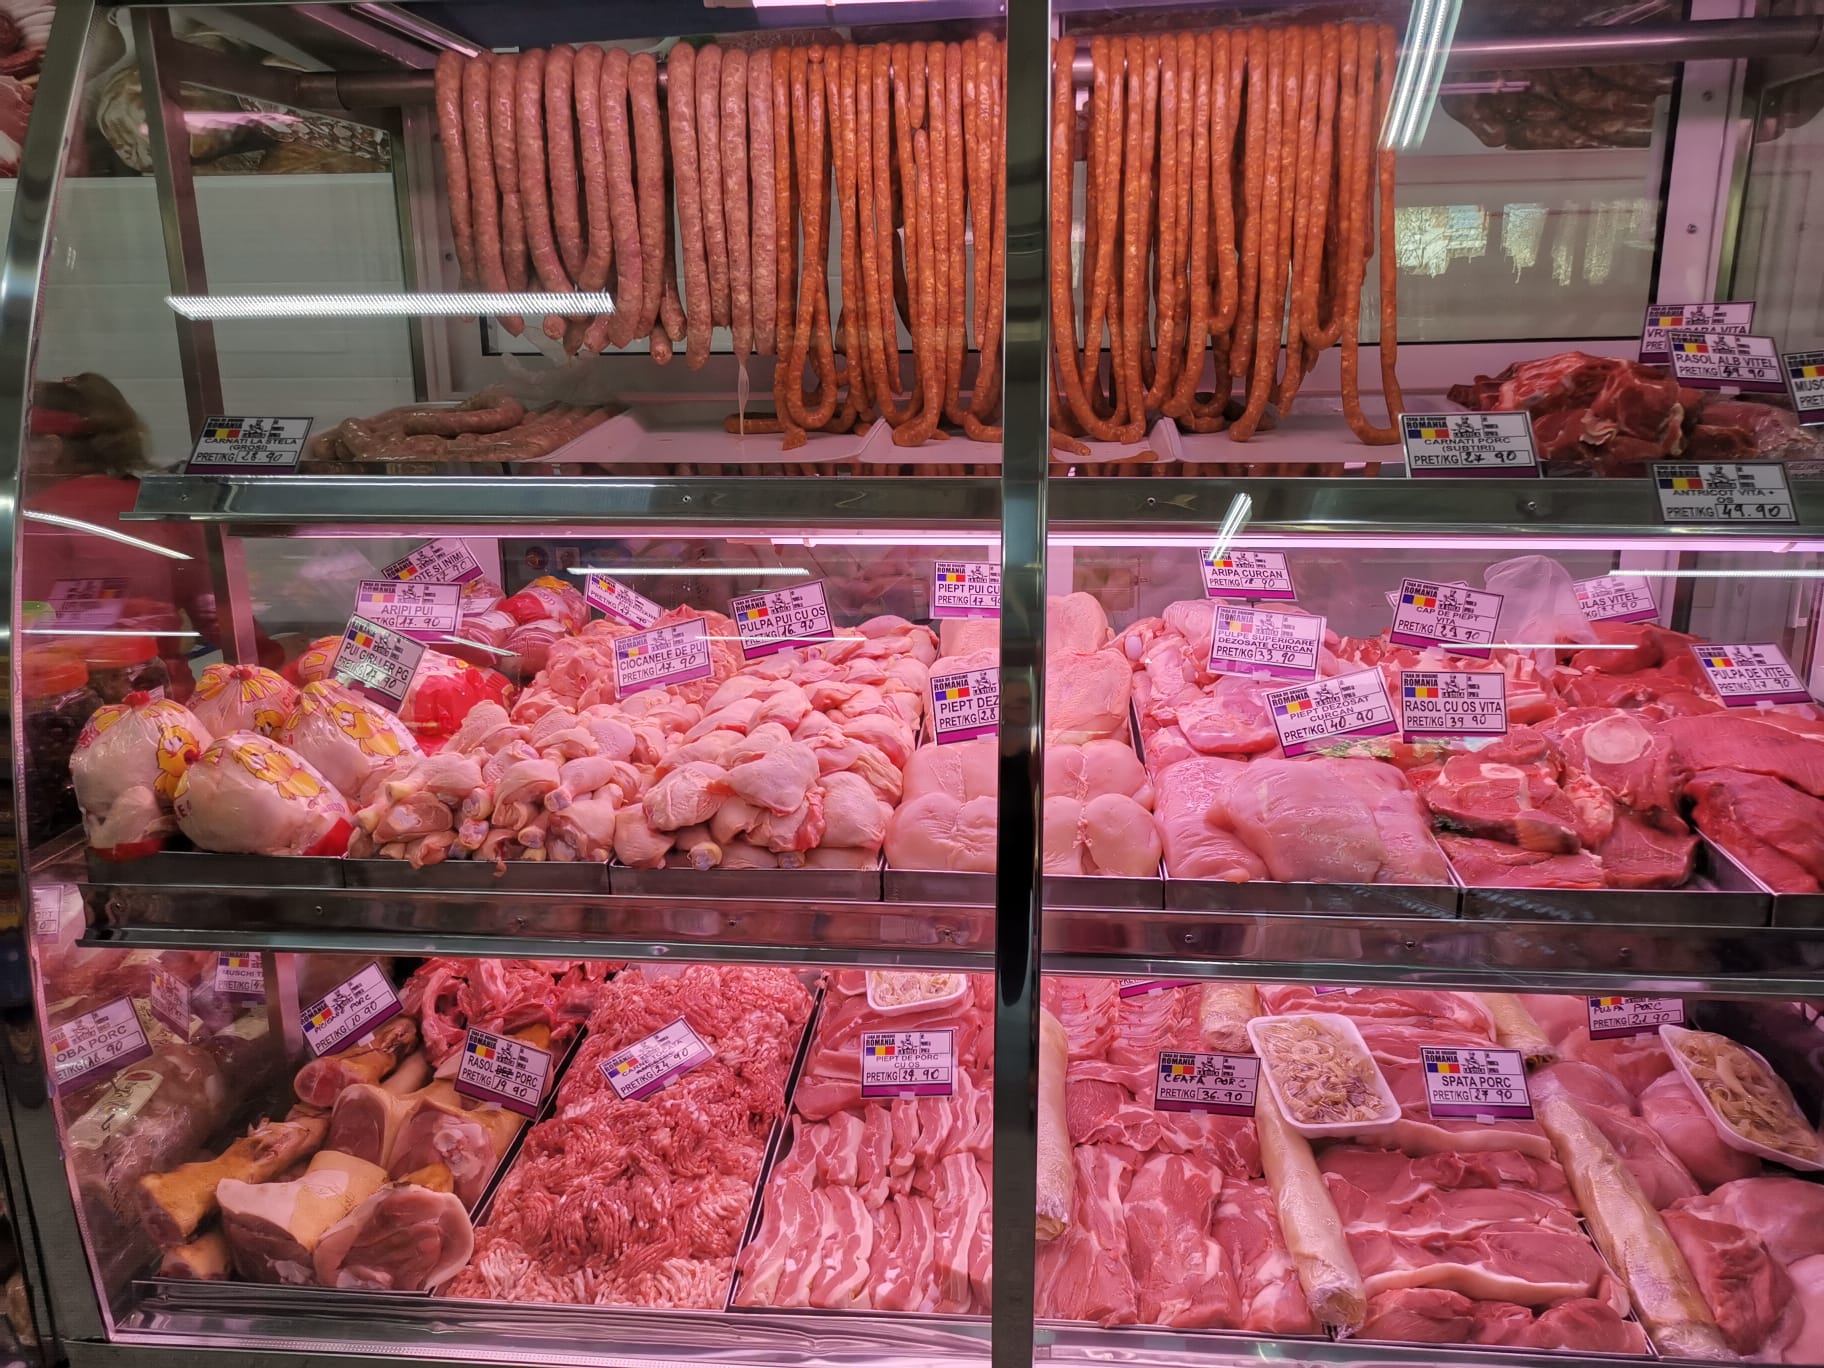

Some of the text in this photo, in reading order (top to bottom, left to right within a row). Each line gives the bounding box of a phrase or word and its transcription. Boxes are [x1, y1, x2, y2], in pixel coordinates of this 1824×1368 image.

[1676, 354, 1716, 364] RASOL
[1719, 356, 1740, 366] ALB
[1744, 358, 1776, 368] VITEL
[1679, 366, 1718, 376] PRET/KG
[196, 452, 235, 461] PRET/KG
[1414, 455, 1459, 464] PRET/KG
[1495, 451, 1516, 463] 90
[1666, 507, 1714, 517] PRET/KG
[434, 563, 442, 574] SI
[443, 552, 464, 568] INIMI
[1212, 569, 1283, 578] ARIPA CURCAN
[938, 583, 966, 593] PIEPT
[968, 584, 985, 594] PUI
[1210, 578, 1240, 586] PRET/KG
[1405, 586, 1438, 598] ROMANIA
[1608, 592, 1639, 603] VITEL
[938, 595, 968, 604] PRET/KG
[381, 605, 434, 615] ARIPI PUI
[736, 601, 766, 613] ROMANIA
[740, 606, 825, 633] PULPA PUI CU OS
[1220, 613, 1253, 623] ROMANIA
[1416, 606, 1436, 615] CAP
[1452, 612, 1480, 622] PIEPT
[800, 619, 814, 632] 90
[1398, 620, 1434, 634] PRET/KG
[1436, 617, 1456, 625] VITA
[1218, 631, 1315, 647] PULPE SUPERIOARE
[1219, 637, 1313, 653] DEZOSATE CURCAN
[620, 641, 705, 670] CIOCANELE DE PUI
[1216, 646, 1253, 658] PRET/KG
[344, 642, 409, 680] PUI PG
[622, 667, 654, 682] PRET/KG
[1712, 667, 1791, 679] PULPA DE VITEL
[934, 679, 969, 691] ROMANIA
[1404, 678, 1438, 686] ROMANIA
[1718, 682, 1751, 691] PRET/KG
[1272, 692, 1310, 707] ROMANIA
[1405, 700, 1502, 712] RASOL CU OS VITA
[940, 699, 974, 714] PIEPT
[1290, 695, 1369, 719] PIEPT DEZOSAT
[939, 713, 977, 728] PRET/KG
[1310, 707, 1354, 722] CURCAN
[1407, 716, 1444, 727] PRET/KG
[1472, 714, 1487, 725] 90
[1284, 724, 1324, 741] PRET/KG
[1633, 1002, 1663, 1012] PORC
[316, 1025, 347, 1050] PRET/KG
[364, 1001, 377, 1015] 90
[1593, 1018, 1627, 1028] PRET/KG
[1653, 1013, 1669, 1023] 90
[88, 1026, 127, 1048] PORC
[468, 1055, 538, 1088] RASOL PORC
[620, 1072, 654, 1093] PRET/KG
[674, 1048, 688, 1060] 90
[866, 1071, 898, 1080] PRET/KG
[462, 1068, 492, 1086] PRET/KG
[513, 1087, 527, 1097] 90
[1441, 1076, 1512, 1088] SPATA PORC
[1160, 1088, 1196, 1098] PRET/KG
[1433, 1090, 1469, 1100] PRET/KG
[1496, 1090, 1513, 1102] 90
